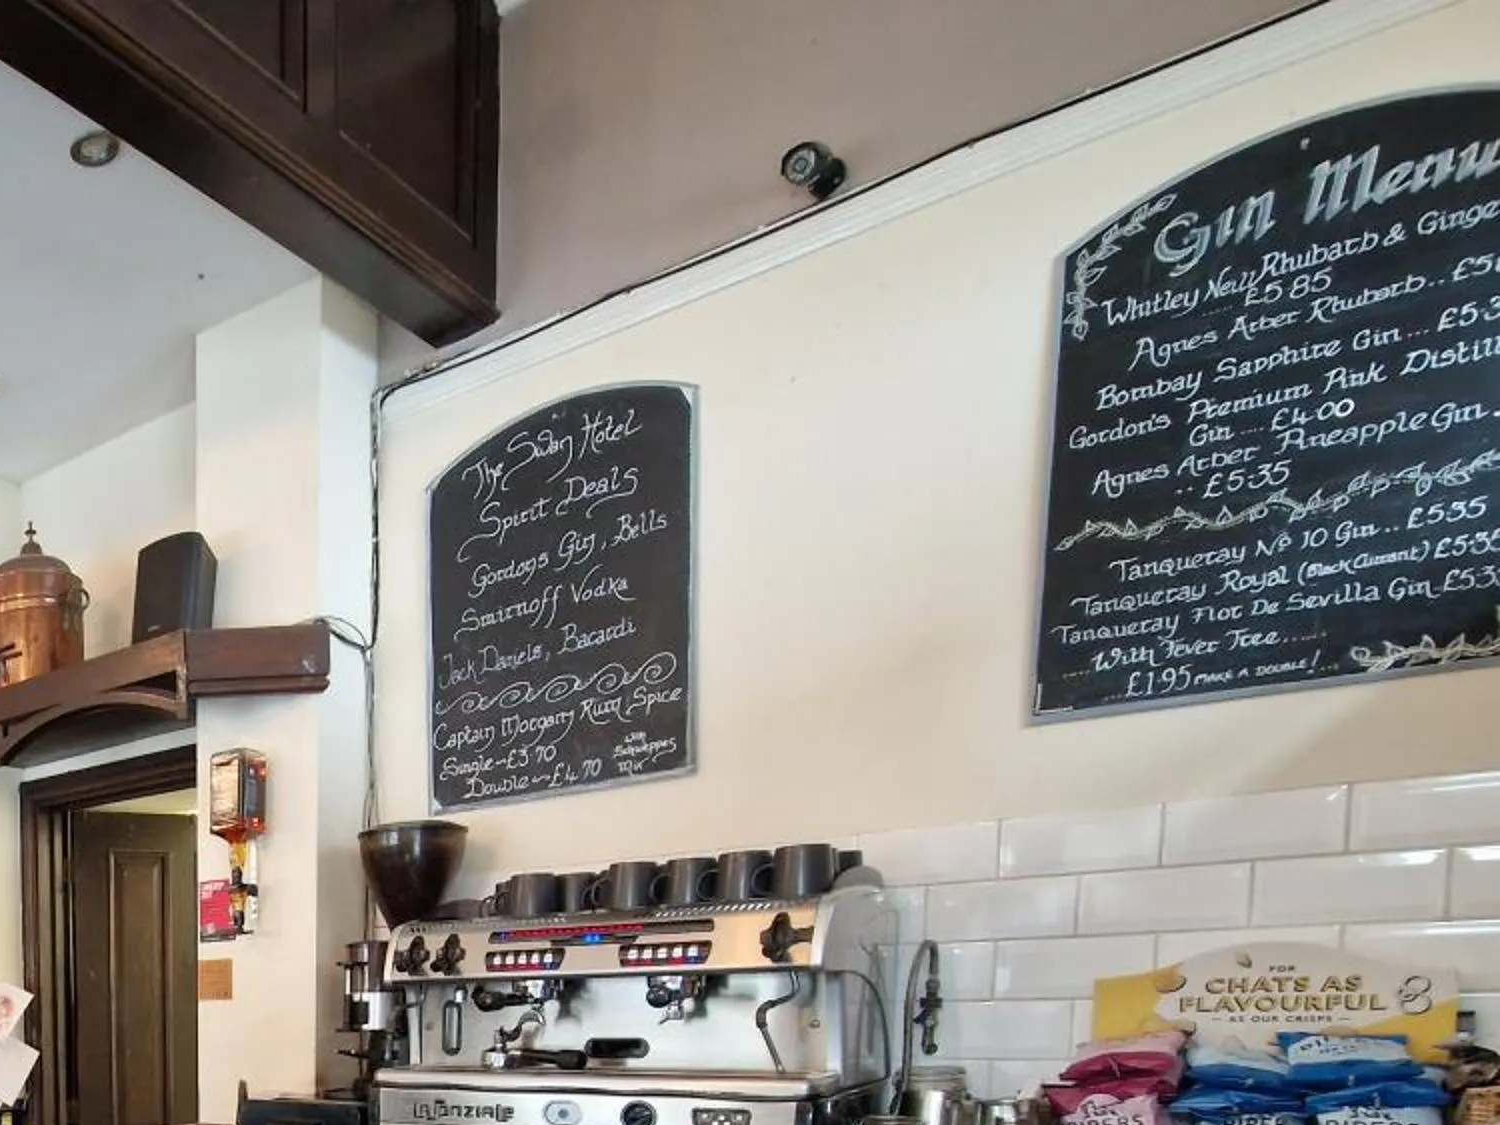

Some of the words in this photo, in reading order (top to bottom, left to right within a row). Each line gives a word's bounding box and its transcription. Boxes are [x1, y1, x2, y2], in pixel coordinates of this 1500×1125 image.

[1154, 191, 1276, 277] Gin
[1303, 138, 1500, 224] Menu
[1102, 288, 1199, 325] Whitley
[1253, 231, 1379, 286] Rhubarb
[1382, 221, 1407, 247] &
[1095, 371, 1202, 411] Bombay
[1212, 339, 1343, 382] Sapphire
[1353, 327, 1402, 351] Gin
[1128, 330, 1219, 371] Agnes
[1228, 312, 1300, 341] Arber
[1069, 413, 1172, 449] Gordon's
[1187, 383, 1313, 424] Premium
[1322, 361, 1388, 394] Pink
[1189, 423, 1235, 447] Gin
[461, 456, 504, 501] The
[577, 408, 642, 460] Hotel
[1091, 463, 1170, 500] Agnes
[1177, 447, 1260, 477] Arber
[1274, 411, 1428, 455] Pineapple
[1431, 402, 1490, 432] Gin
[1203, 459, 1292, 500] £5.35
[458, 497, 552, 562] Spirit
[556, 465, 640, 519] Deals
[468, 551, 549, 599] Gordons
[611, 508, 669, 547] Bells
[1108, 545, 1247, 582] Tanqueray
[1335, 519, 1380, 547] Gin
[453, 585, 563, 643] Smirnoff
[570, 564, 638, 604] Vodka
[1051, 614, 1180, 645] Tanqueray
[1251, 599, 1279, 616] De
[1285, 582, 1381, 610] Sevilla
[1387, 576, 1440, 600] Gin
[1069, 582, 1206, 617] Tanqueray
[1215, 566, 1290, 595] Royal
[440, 653, 486, 689] Jack
[557, 616, 637, 655] Bacardi
[1158, 635, 1221, 659] Fever
[1225, 628, 1282, 650] Tree
[434, 723, 495, 753] Captain
[500, 709, 575, 748] Morgan
[580, 696, 632, 725] Rum
[1205, 975, 1310, 994] CHATS
[1320, 974, 1363, 993] AS
[1269, 964, 1296, 973] FOR
[1179, 993, 1388, 1014] FLAVOURFUL
